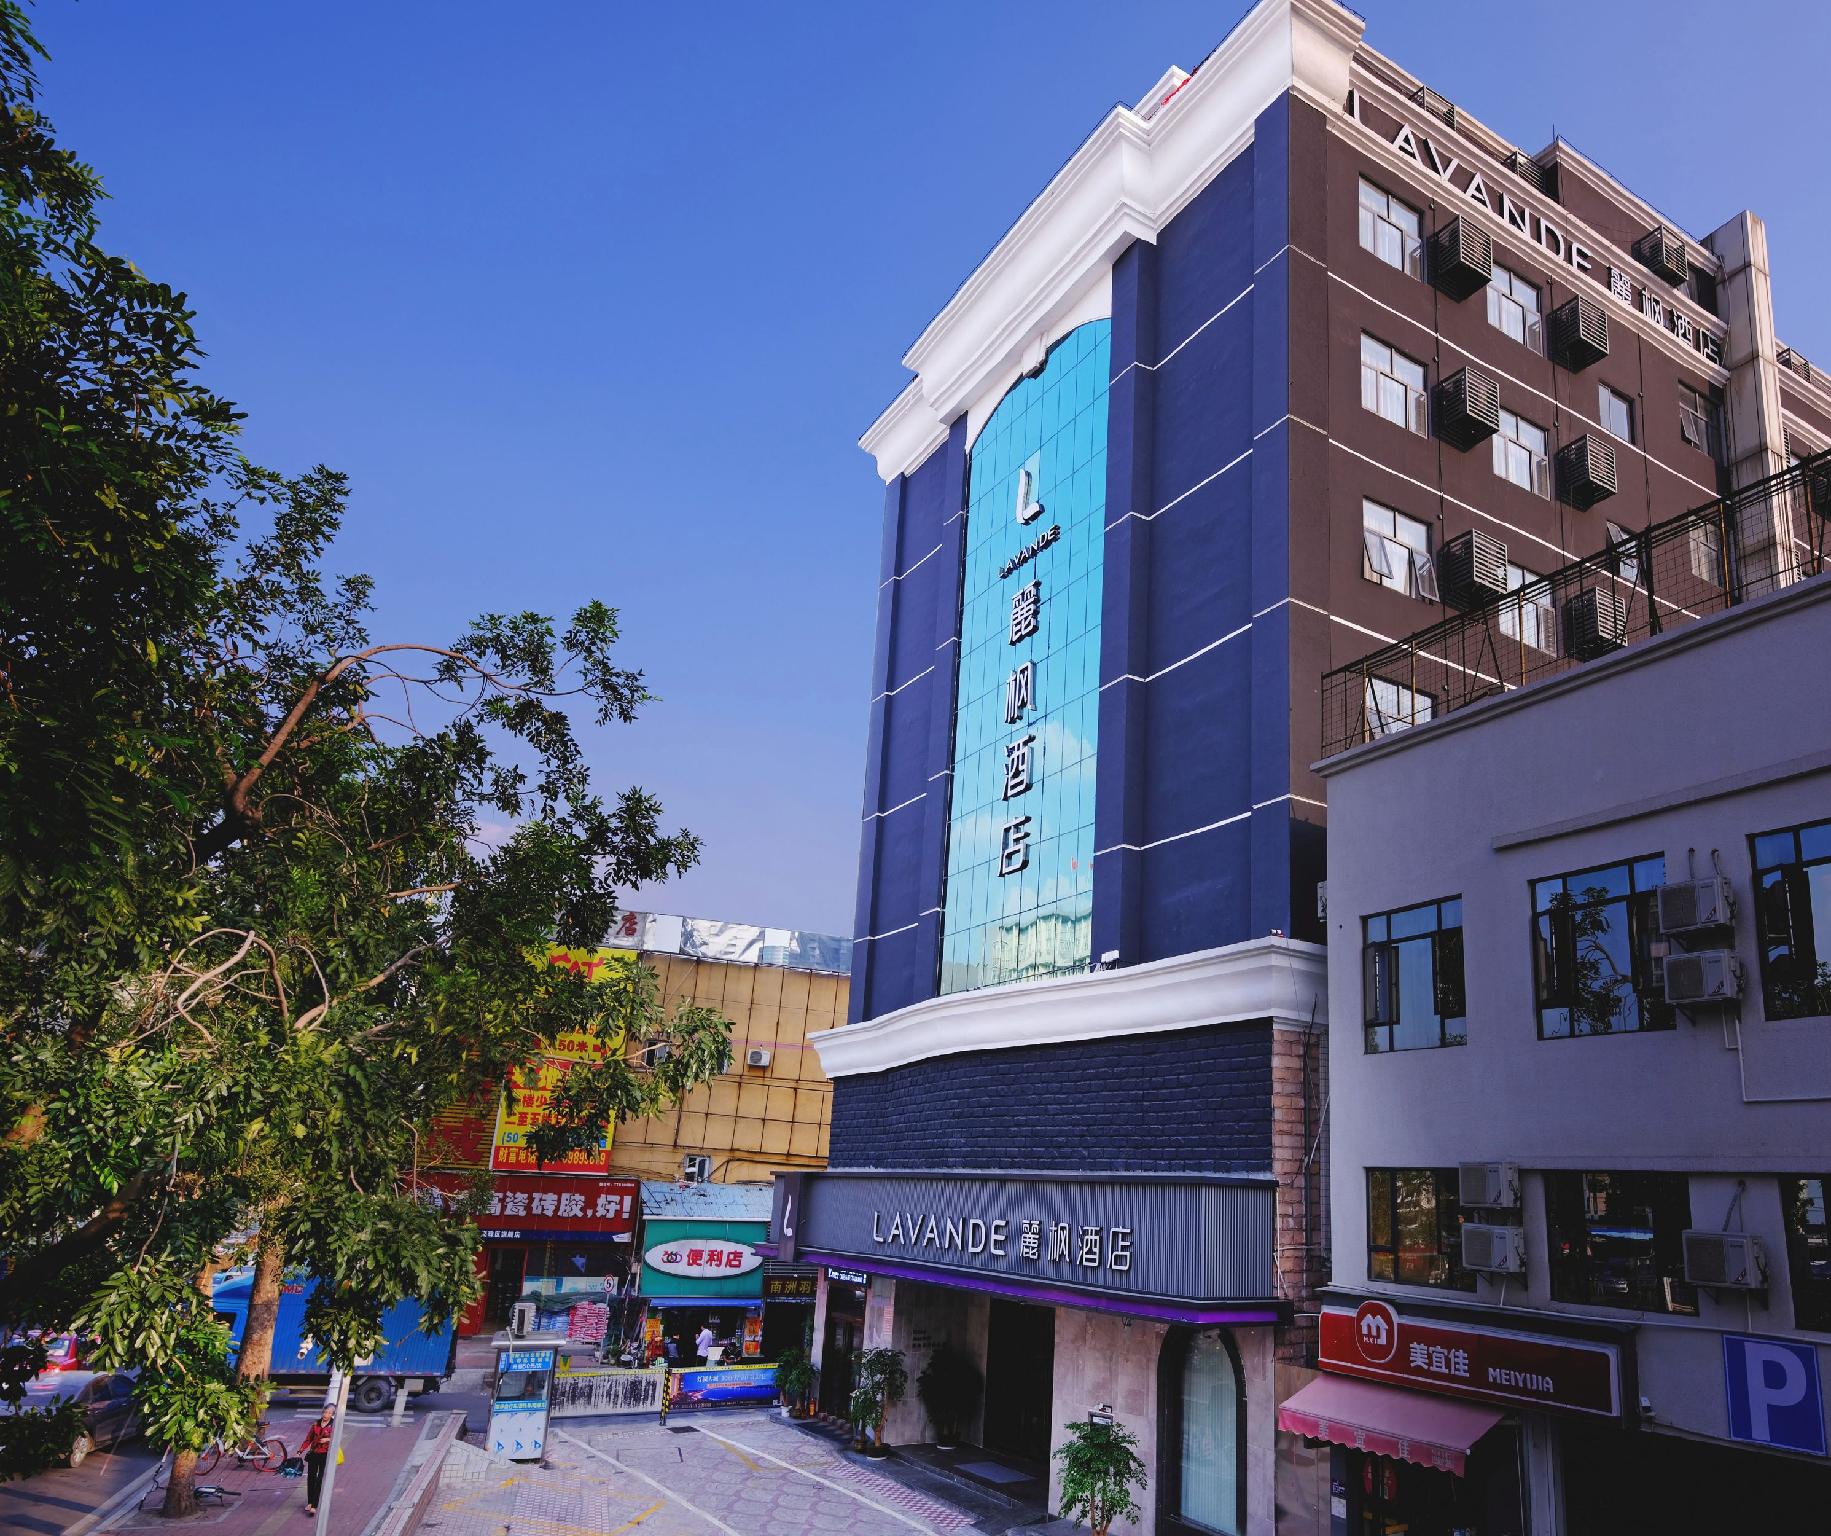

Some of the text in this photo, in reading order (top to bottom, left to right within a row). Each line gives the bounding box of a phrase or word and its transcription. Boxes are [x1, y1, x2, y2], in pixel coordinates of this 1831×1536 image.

[1352, 87, 1593, 271] LAVANDE
[1016, 469, 1043, 525] L
[686, 1248, 744, 1268] 便利店
[873, 1211, 1133, 1271] LAVANDE 麗枫酒店
[770, 1280, 818, 1294] 南洲羽
[1409, 1342, 1555, 1393] 美宜佳 MEIYIJIA
[1743, 1341, 1807, 1442] P
